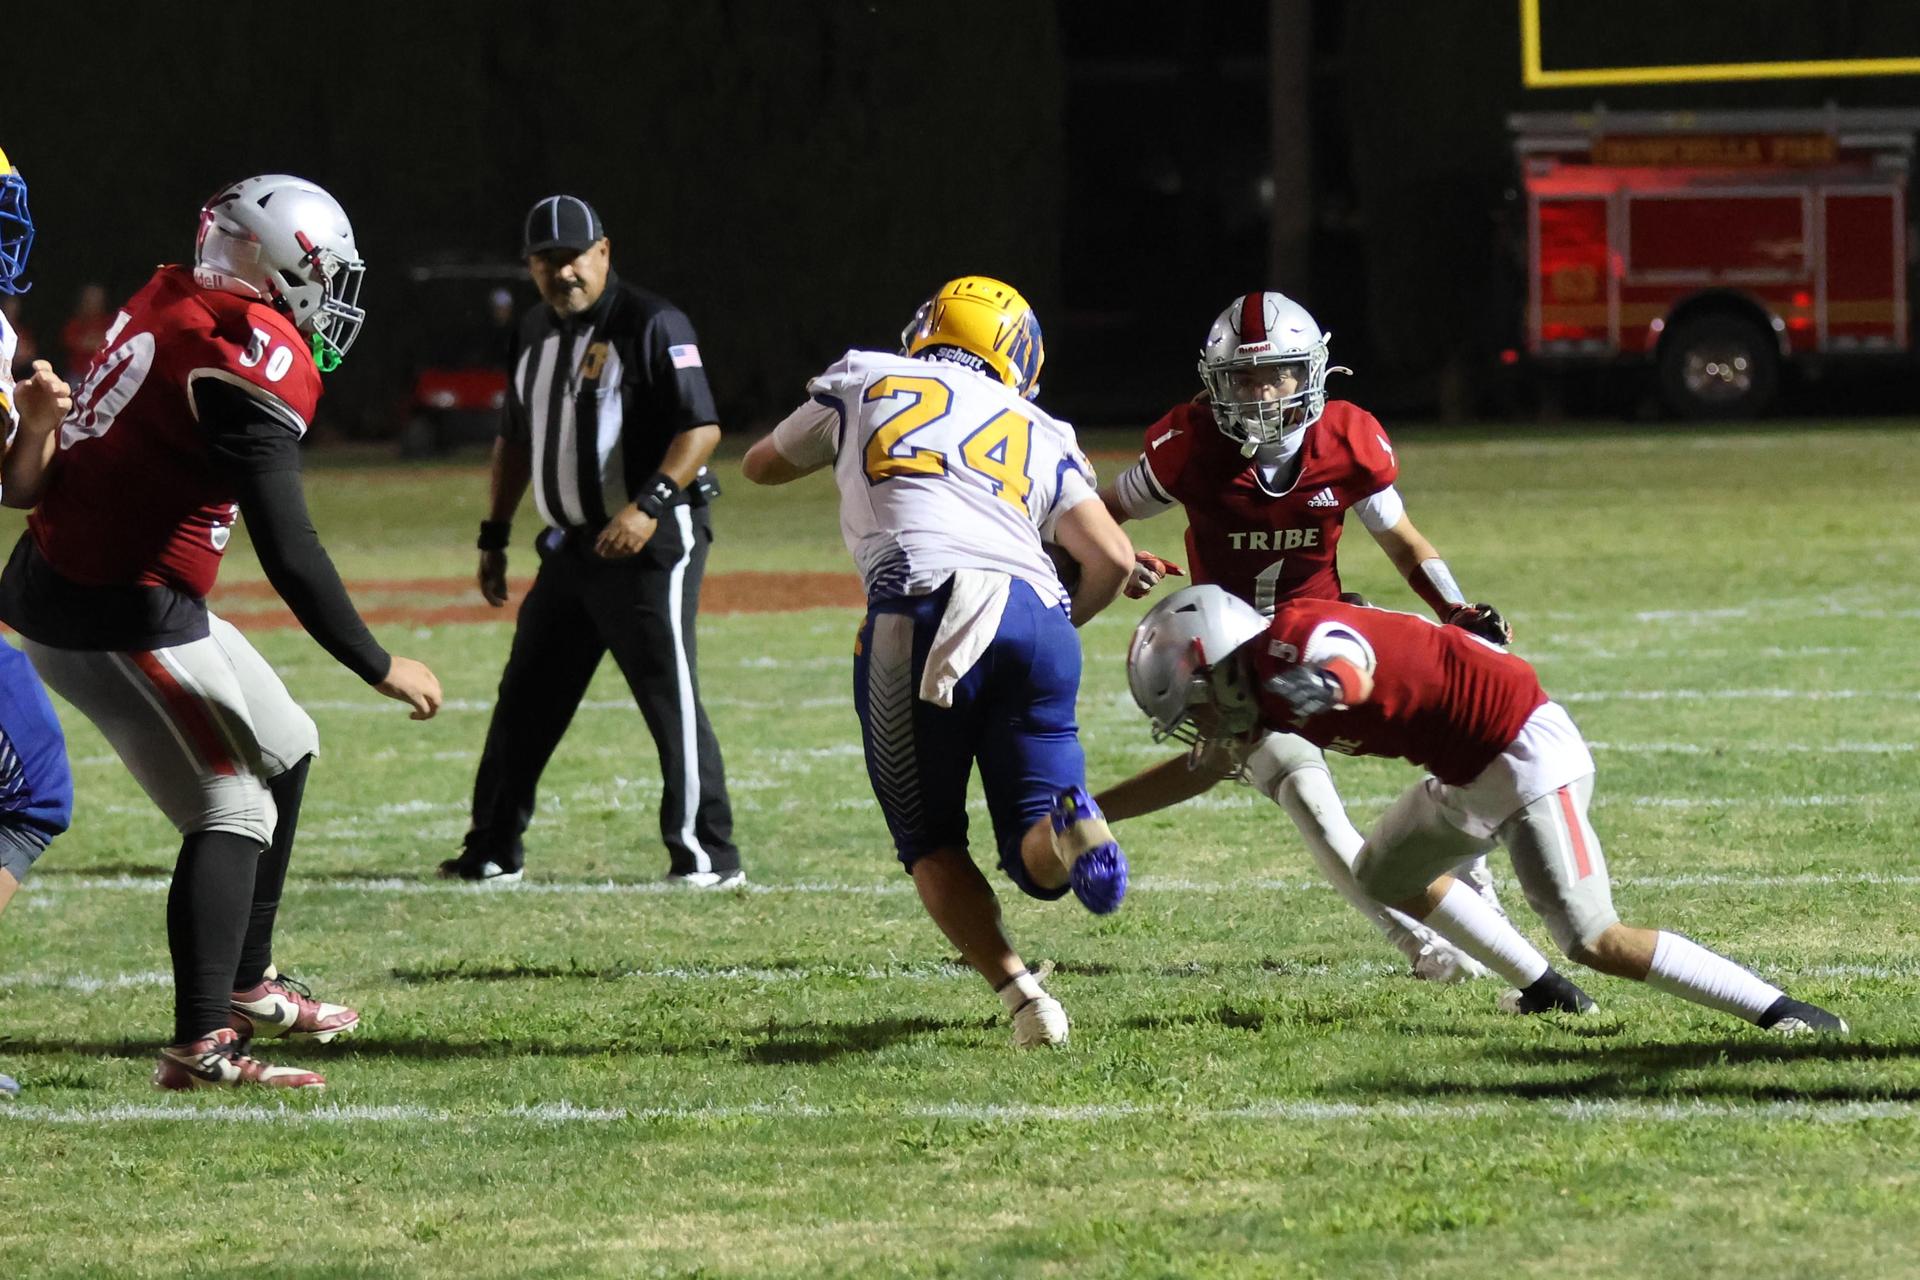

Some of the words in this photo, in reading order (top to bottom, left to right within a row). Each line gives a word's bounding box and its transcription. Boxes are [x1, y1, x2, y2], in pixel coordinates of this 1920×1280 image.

[238, 327, 294, 382] 50
[936, 347, 985, 371] schutt
[863, 375, 1034, 522] 24
[1151, 429, 1185, 451] 1
[1307, 499, 1339, 508] adidas
[1228, 528, 1320, 551] TRIBE
[1253, 558, 1285, 620] 1
[1267, 639, 1299, 663] 5
